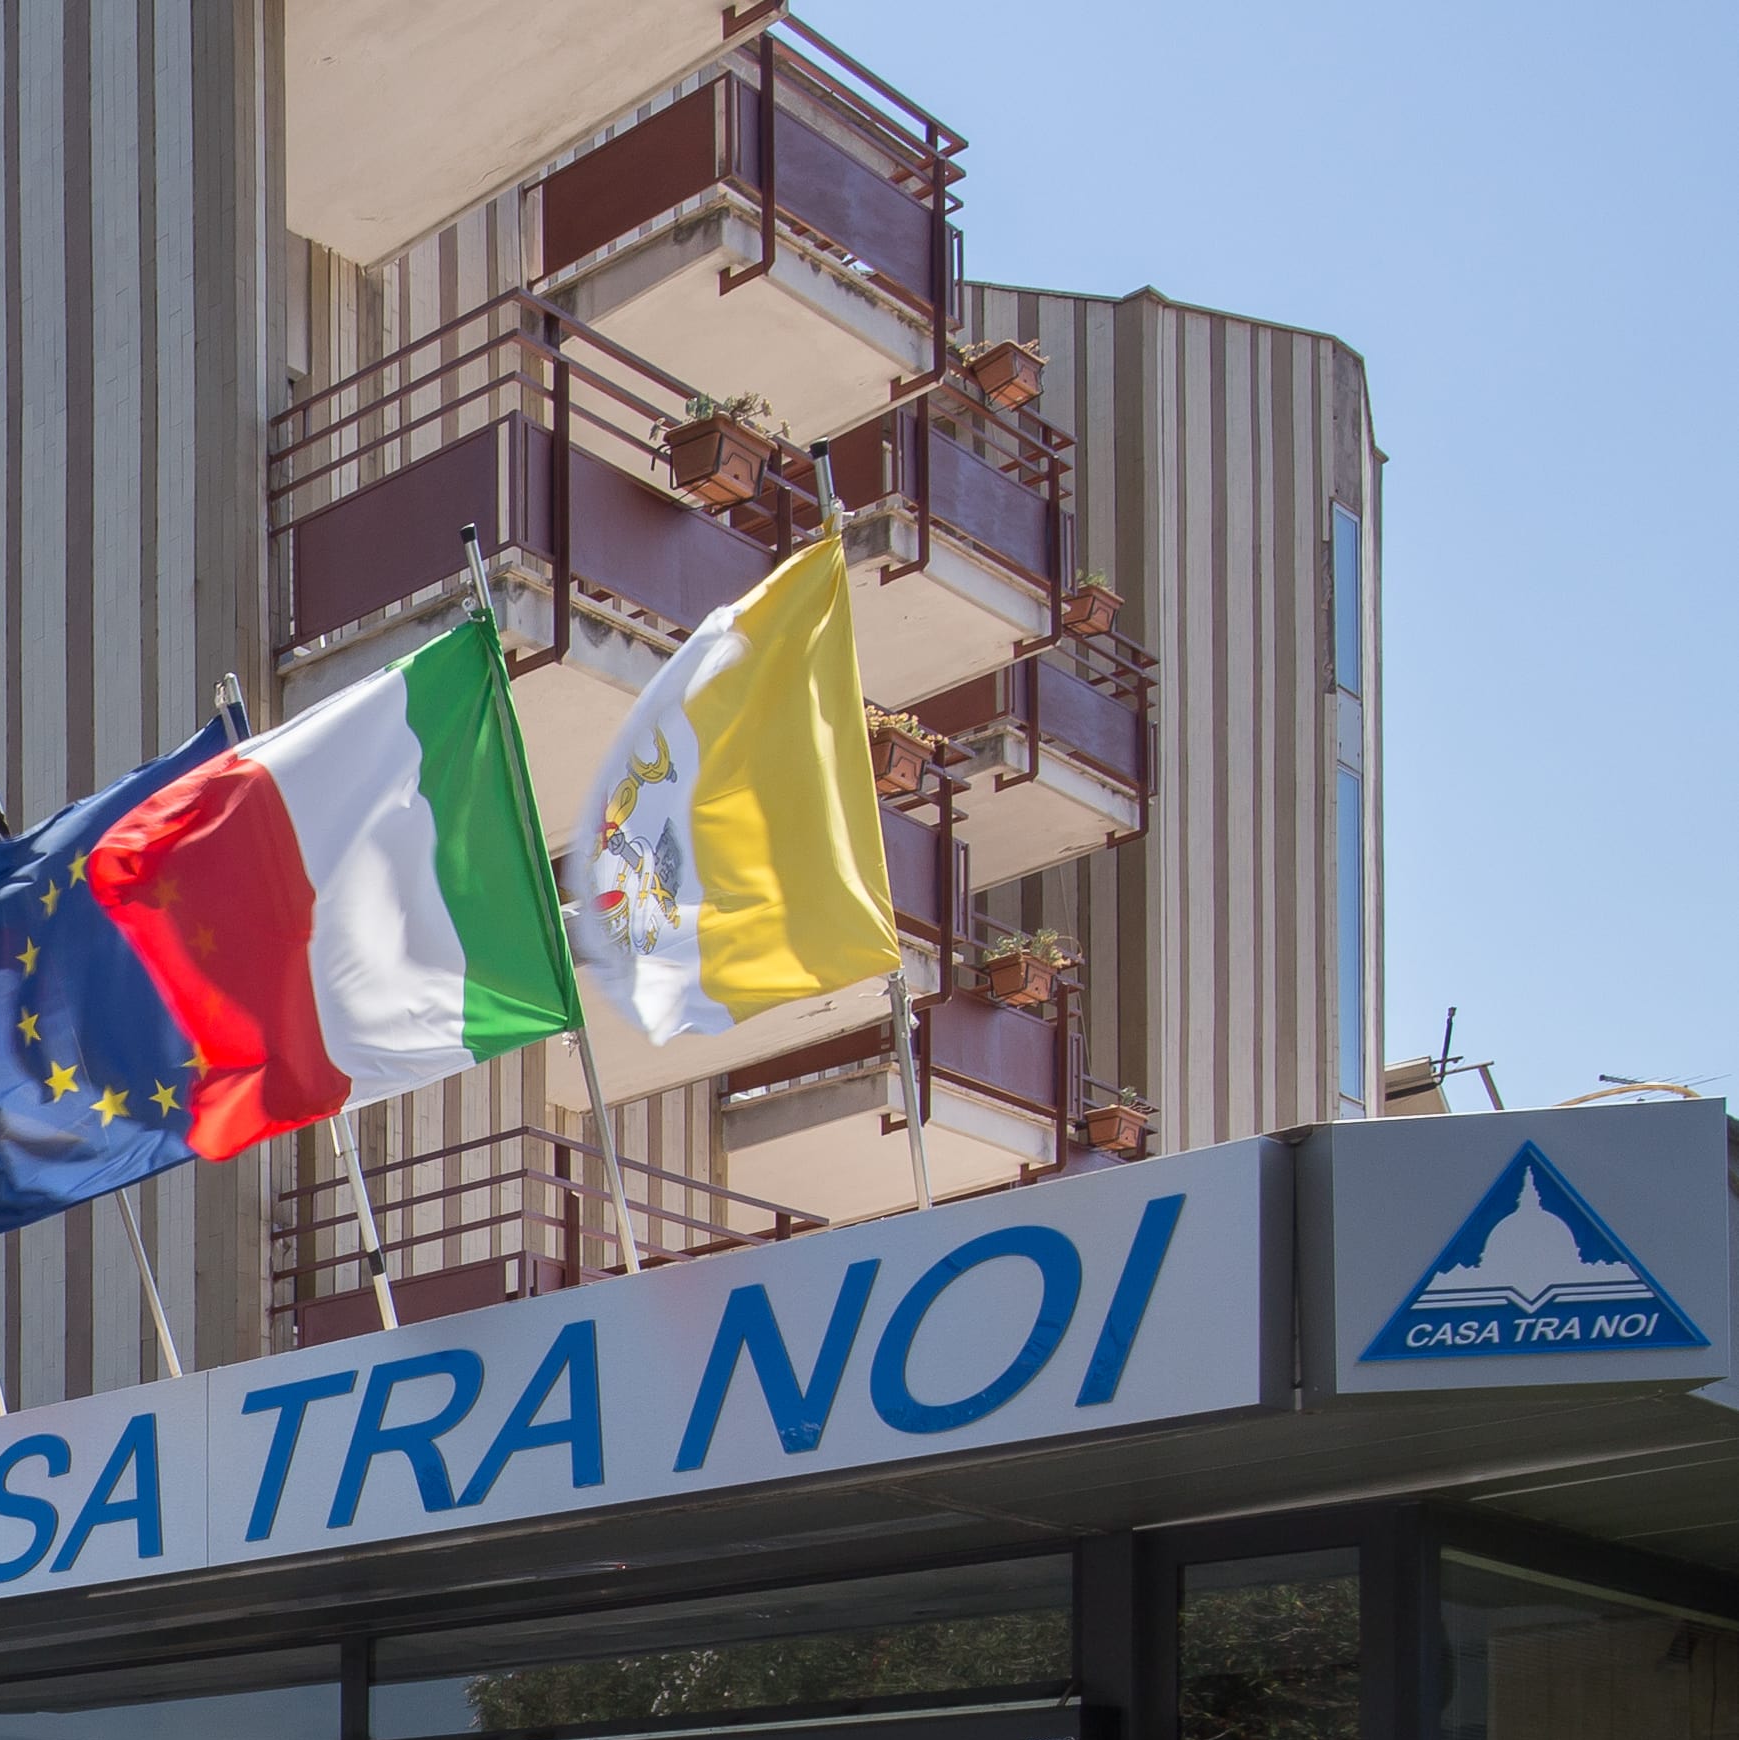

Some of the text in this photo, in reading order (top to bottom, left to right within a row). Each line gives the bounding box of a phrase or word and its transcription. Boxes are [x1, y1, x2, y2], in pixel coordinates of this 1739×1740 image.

[241, 1319, 605, 1542] TRA
[673, 1193, 1186, 1472] NOI
[1405, 1312, 1660, 1348] CASA TRA NOI
